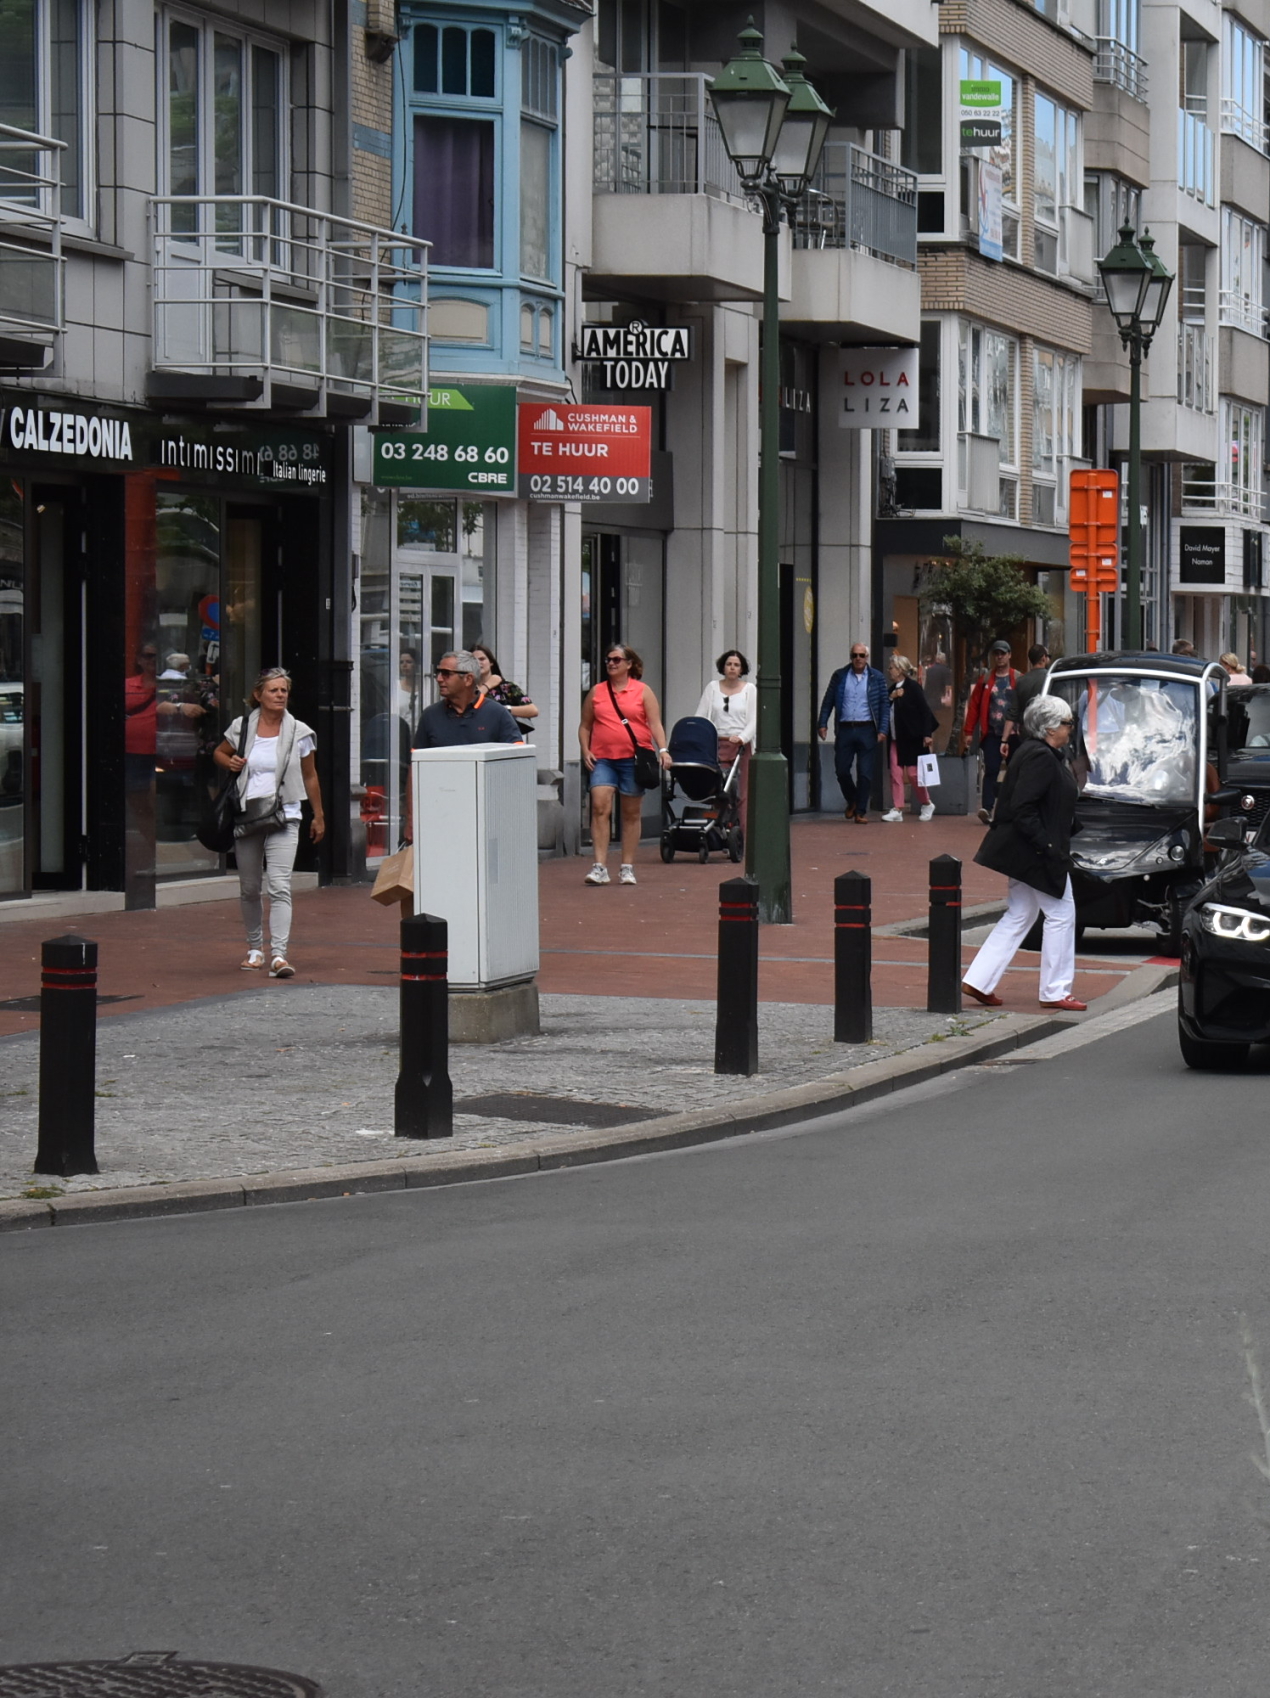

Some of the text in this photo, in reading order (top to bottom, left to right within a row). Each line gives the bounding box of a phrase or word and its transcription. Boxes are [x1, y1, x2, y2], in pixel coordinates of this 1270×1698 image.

[962, 93, 1000, 101] vandewalle
[585, 330, 686, 357] AMERICA
[603, 361, 669, 389] TODAY
[844, 371, 909, 387] LOLA
[844, 397, 909, 413] LIZA
[568, 413, 637, 424] CUSHMAN &
[10, 406, 133, 461] CALZEDONIA
[568, 423, 638, 433] WAKEFIELD
[381, 442, 509, 464] 03 248 68 60
[531, 442, 608, 457] TE HUUR
[273, 460, 296, 480] Italian
[298, 463, 326, 486] lingerie
[468, 472, 508, 484] CBRE
[530, 475, 639, 495] 02 514 40 00
[1184, 543, 1220, 554] David Mayer
